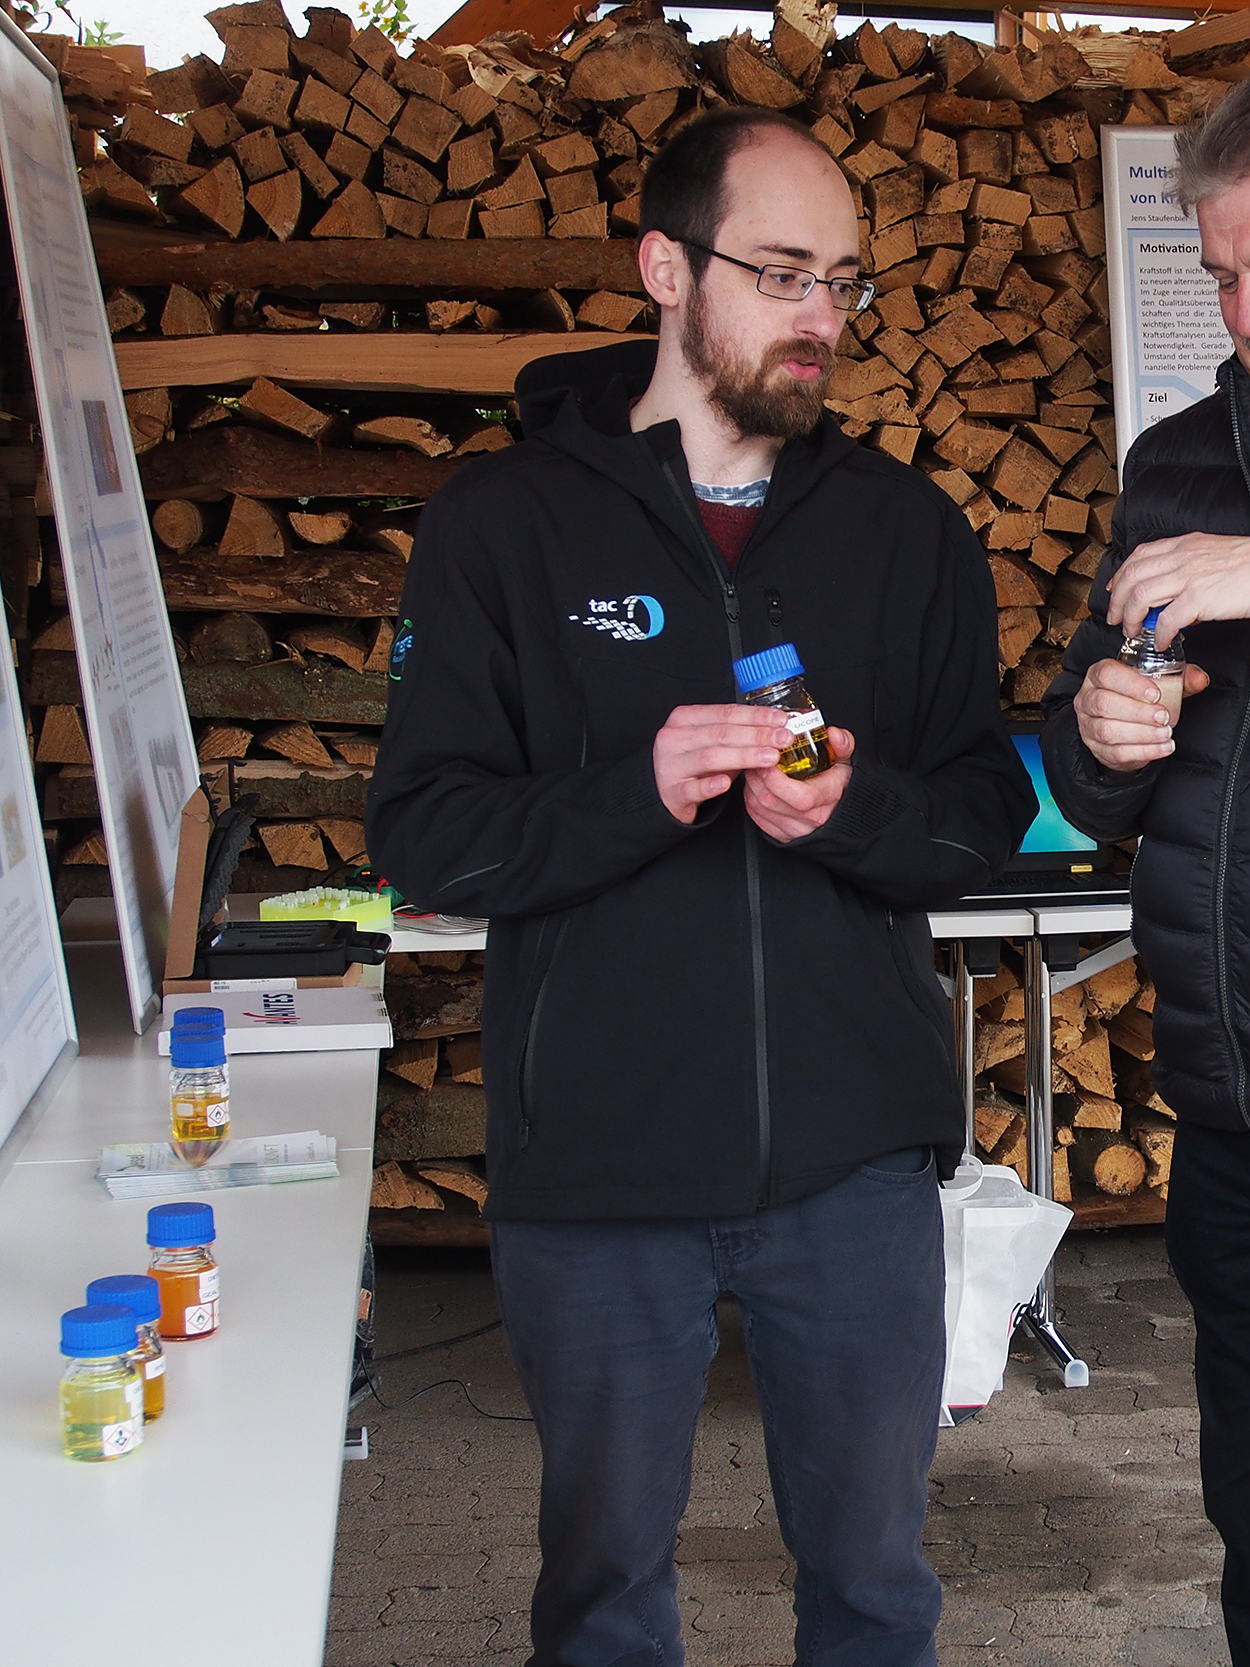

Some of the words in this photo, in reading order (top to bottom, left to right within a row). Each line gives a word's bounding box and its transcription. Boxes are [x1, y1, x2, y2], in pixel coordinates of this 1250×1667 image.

[1130, 194, 1157, 204] von
[1140, 243, 1199, 253] Motivation
[1139, 267, 1172, 275] Kraftstoff
[1152, 289, 1170, 297] Zuge
[1142, 321, 1175, 329] wichtiges
[1142, 332, 1206, 340] Kraftstoffanalysen
[1143, 342, 1197, 350] Notwendigkeit.
[1148, 392, 1168, 402] Ziel
[588, 598, 618, 613] tac
[243, 993, 301, 1025] AVANTES
